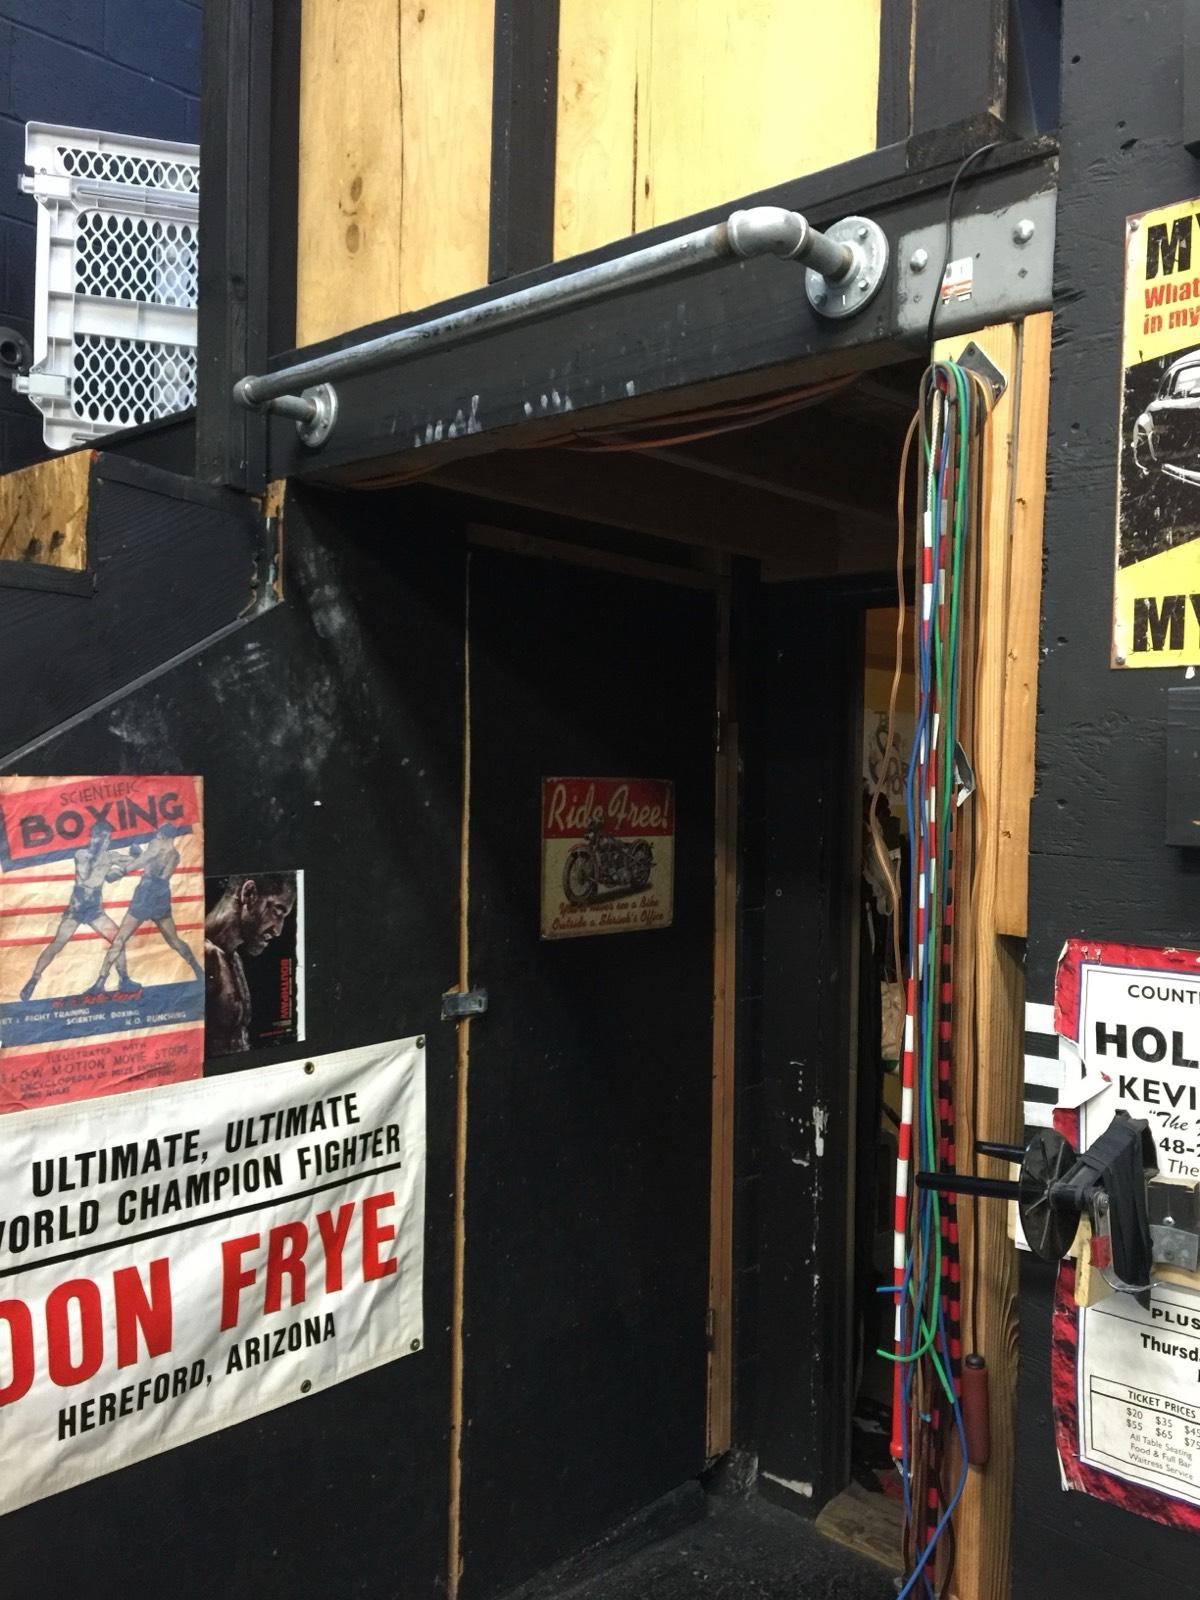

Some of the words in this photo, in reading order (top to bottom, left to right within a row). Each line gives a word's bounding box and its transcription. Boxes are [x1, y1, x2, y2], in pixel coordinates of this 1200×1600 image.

[1145, 214, 1200, 280] M
[1144, 313, 1163, 335] in
[1169, 305, 1200, 330] my
[1133, 593, 1200, 653] M
[60, 781, 140, 807] SCIENTIFIC
[547, 782, 604, 831] Ride
[608, 783, 669, 831] Free!
[20, 791, 184, 849] BOXING
[640, 909, 665, 926] Office
[1128, 984, 1200, 1005] COUNT
[24, 1012, 50, 1022] FIGHT
[53, 1007, 90, 1018] TRAINING
[110, 1009, 140, 1020] BOXING
[146, 1010, 187, 1023] PUNCHING
[1095, 1021, 1200, 1069] HOL
[52, 1057, 106, 1076] MOTION
[114, 1050, 145, 1066] MOVIE
[1119, 1074, 1196, 1111] KEVI
[32, 1129, 209, 1198] ULTIMATE,
[225, 1092, 361, 1153] ULTIMATE
[117, 1154, 283, 1226] CHAMPION
[299, 1123, 401, 1180] FIGHTER
[1168, 1158, 1200, 1177] The
[0, 1257, 173, 1408] DON
[220, 1191, 398, 1333] FRYE
[1152, 1307, 1200, 1330] PLUS
[1140, 1332, 1200, 1362] Thursd
[57, 1358, 212, 1441] HEREFORD,
[226, 1312, 336, 1376] ARIZONA
[1126, 1407, 1143, 1420] $20
[1155, 1416, 1173, 1428] $35
[1127, 1390, 1160, 1407] TICKET
[1164, 1401, 1196, 1419] PRICES
[1126, 1418, 1143, 1431] $55
[1155, 1427, 1173, 1440] $65
[1130, 1433, 1140, 1443] All
[1143, 1436, 1162, 1449] Table
[1165, 1443, 1192, 1461] Seating
[1130, 1442, 1151, 1456] Food
[1153, 1450, 1160, 1458] &
[1162, 1452, 1176, 1463] Full
[1178, 1458, 1191, 1468] Bar
[1128, 1452, 1163, 1470] Waitress
[1165, 1464, 1193, 1480] Service
